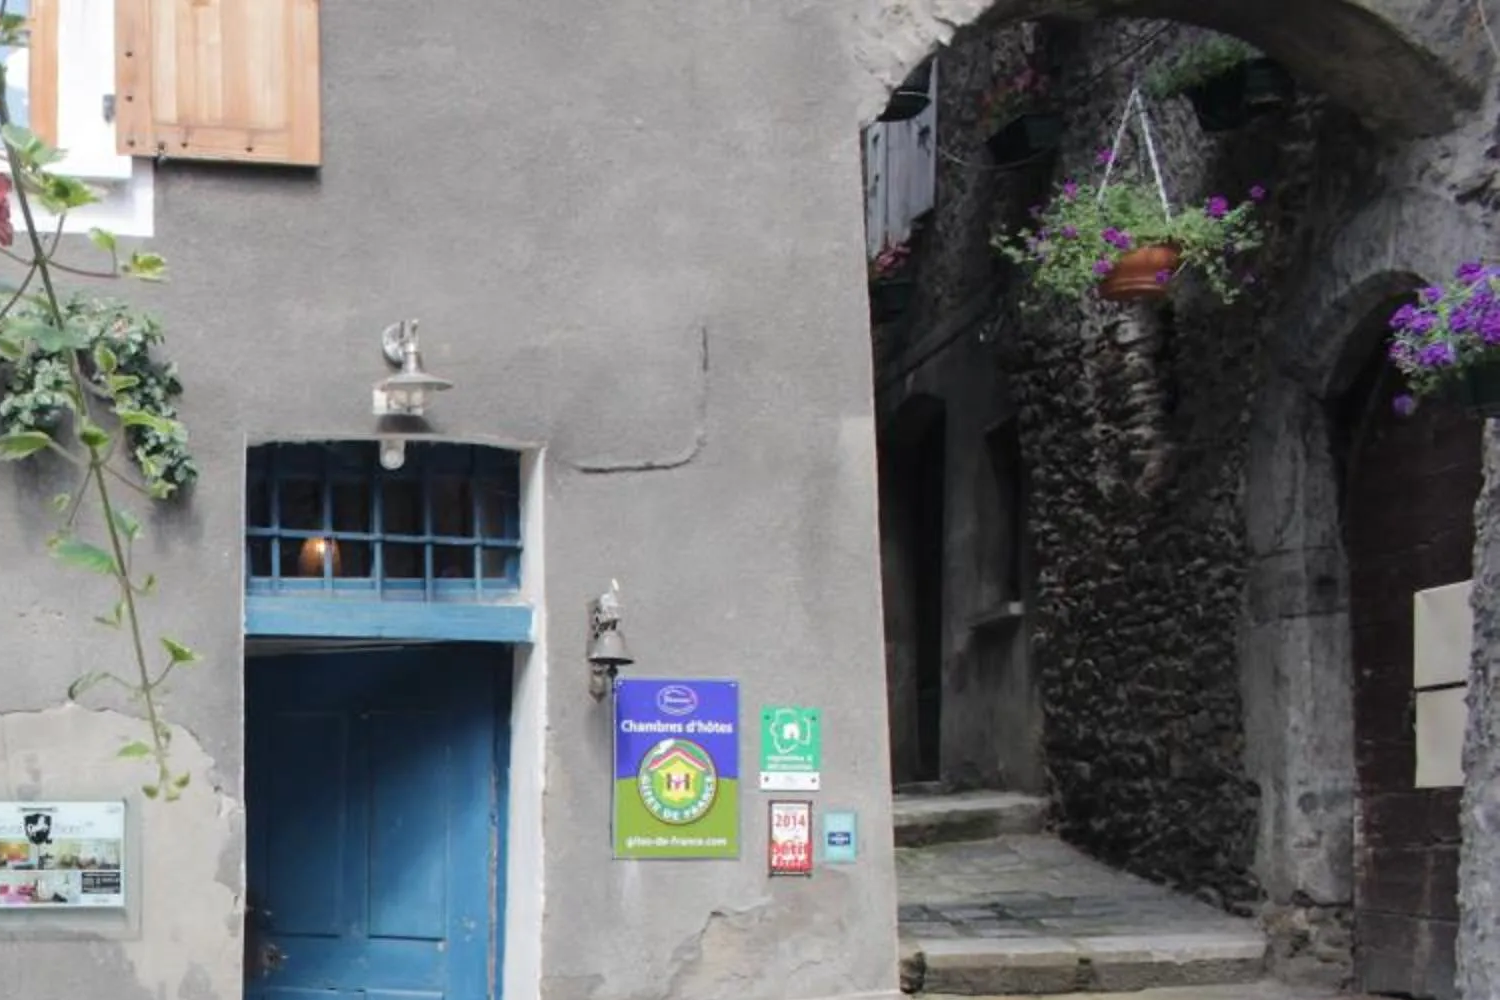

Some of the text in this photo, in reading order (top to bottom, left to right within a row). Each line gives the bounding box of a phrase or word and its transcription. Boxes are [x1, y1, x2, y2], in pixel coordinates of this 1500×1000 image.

[621, 719, 734, 734] Chambres d'hôtes
[775, 813, 807, 828] 2014
